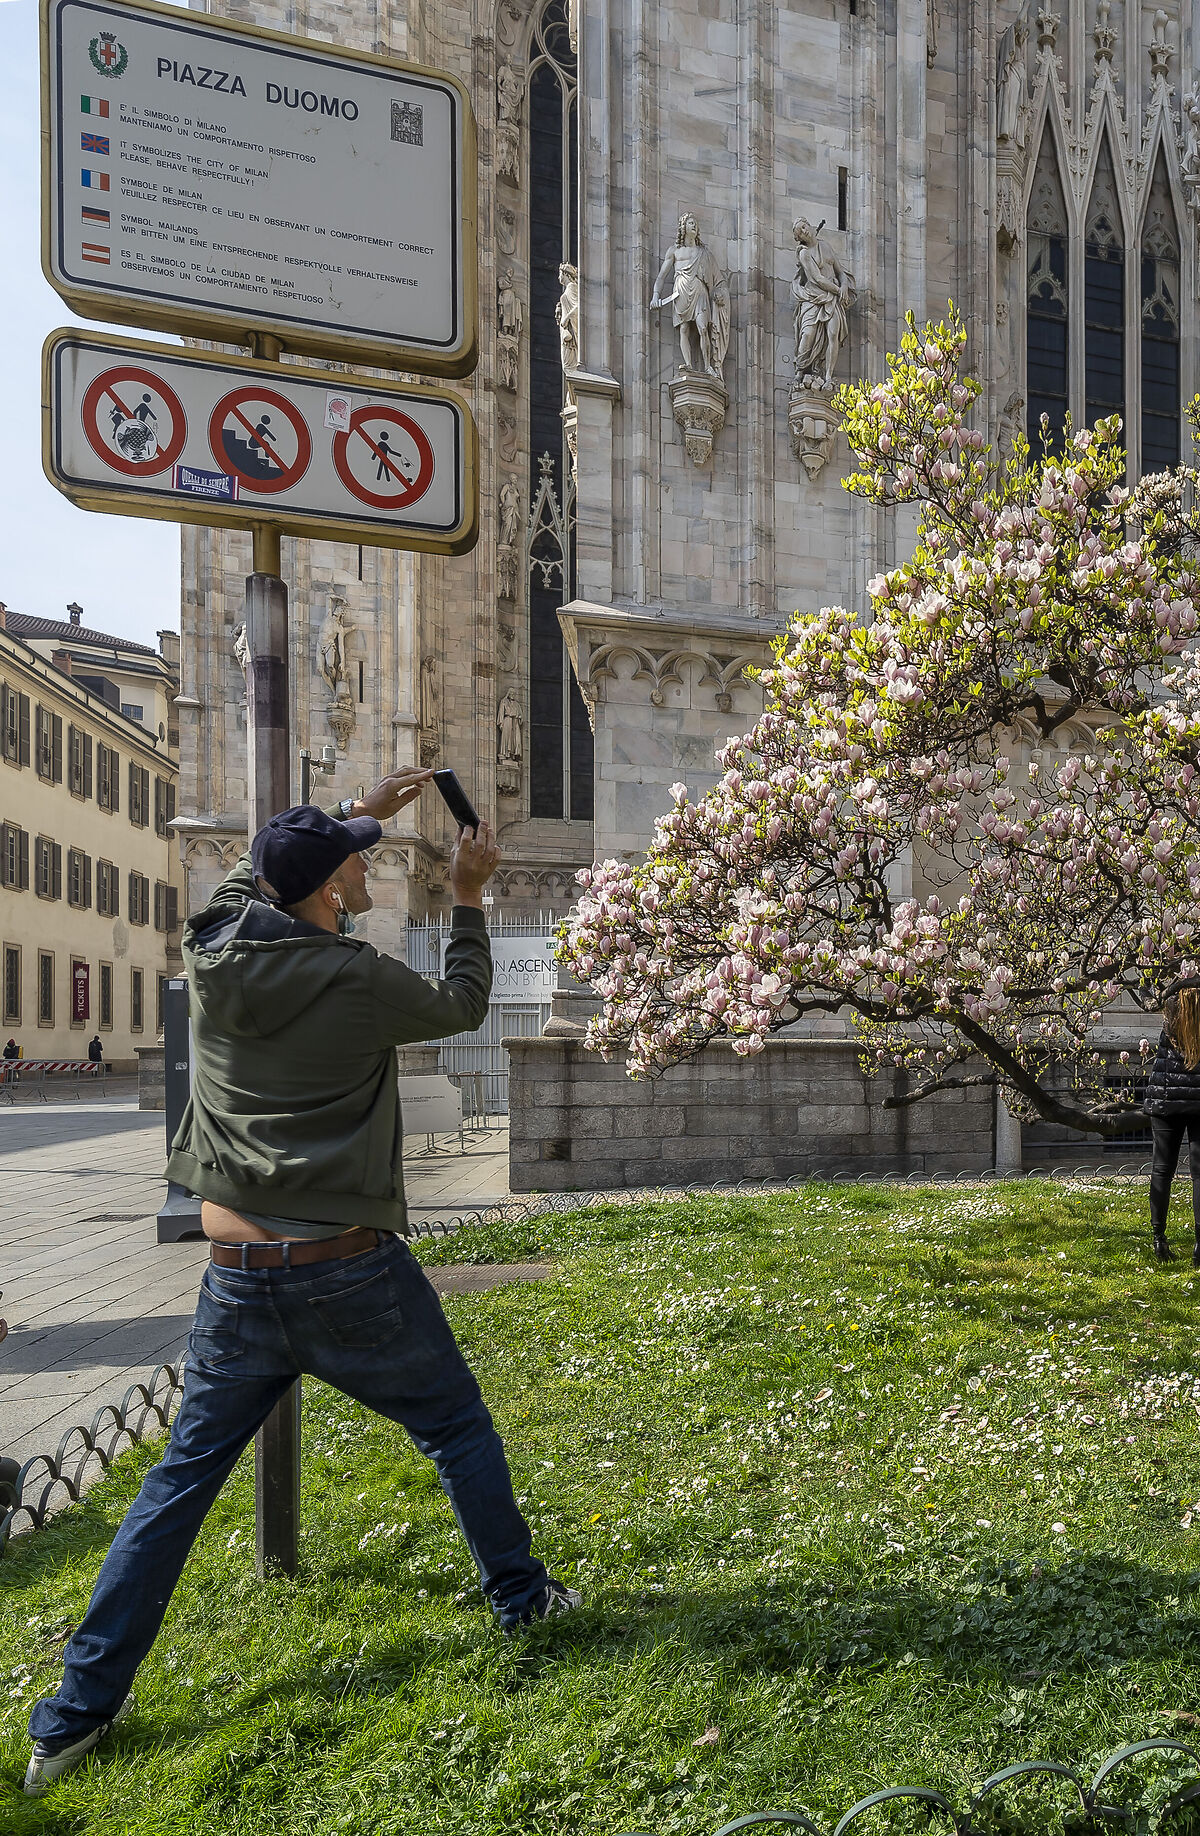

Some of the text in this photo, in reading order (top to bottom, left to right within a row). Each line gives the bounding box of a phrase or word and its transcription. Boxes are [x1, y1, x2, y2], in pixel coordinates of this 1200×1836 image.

[157, 57, 359, 121] PIAZZA DUOMO
[144, 109, 179, 123] SIMBOLO
[184, 118, 192, 126] DI
[196, 121, 227, 133] MILANO
[120, 115, 317, 164] MANTENIAMO UN COMPORTAMENTO RISPETTOSO
[120, 152, 152, 166] PLEASE,
[156, 160, 187, 172] BEHAVE
[132, 143, 182, 160] SYMBOLIZES
[186, 155, 202, 164] THE
[207, 159, 224, 169] CITY
[229, 164, 240, 172] OF
[244, 168, 269, 179] MILAN
[120, 177, 203, 200] SYMBOLE DE MILAN
[121, 188, 434, 255] VEUILLEZ RESPECTER CE LIEU EN OBSERVANT UN COMPORTEMENT CORRECT
[121, 214, 199, 236] SYMBOL MAILANDS
[121, 225, 419, 287] WIR BITTEN UM EINE ENTSPRECHENDE RESPEKTVOLLE VERHALTENSWEISE
[121, 250, 295, 288] ES EL SIMBOLO DE LA CIUDAD DE MILAN
[121, 261, 324, 305] OBSERVEMOS UN COMPORTAMIENTO RESPETUOSO
[191, 485, 220, 495] FIRENZE
[208, 476, 230, 491] SEMPRE
[508, 959, 558, 972] ASCENS
[523, 973, 538, 986] BY
[77, 980, 85, 1012] TICKETS
